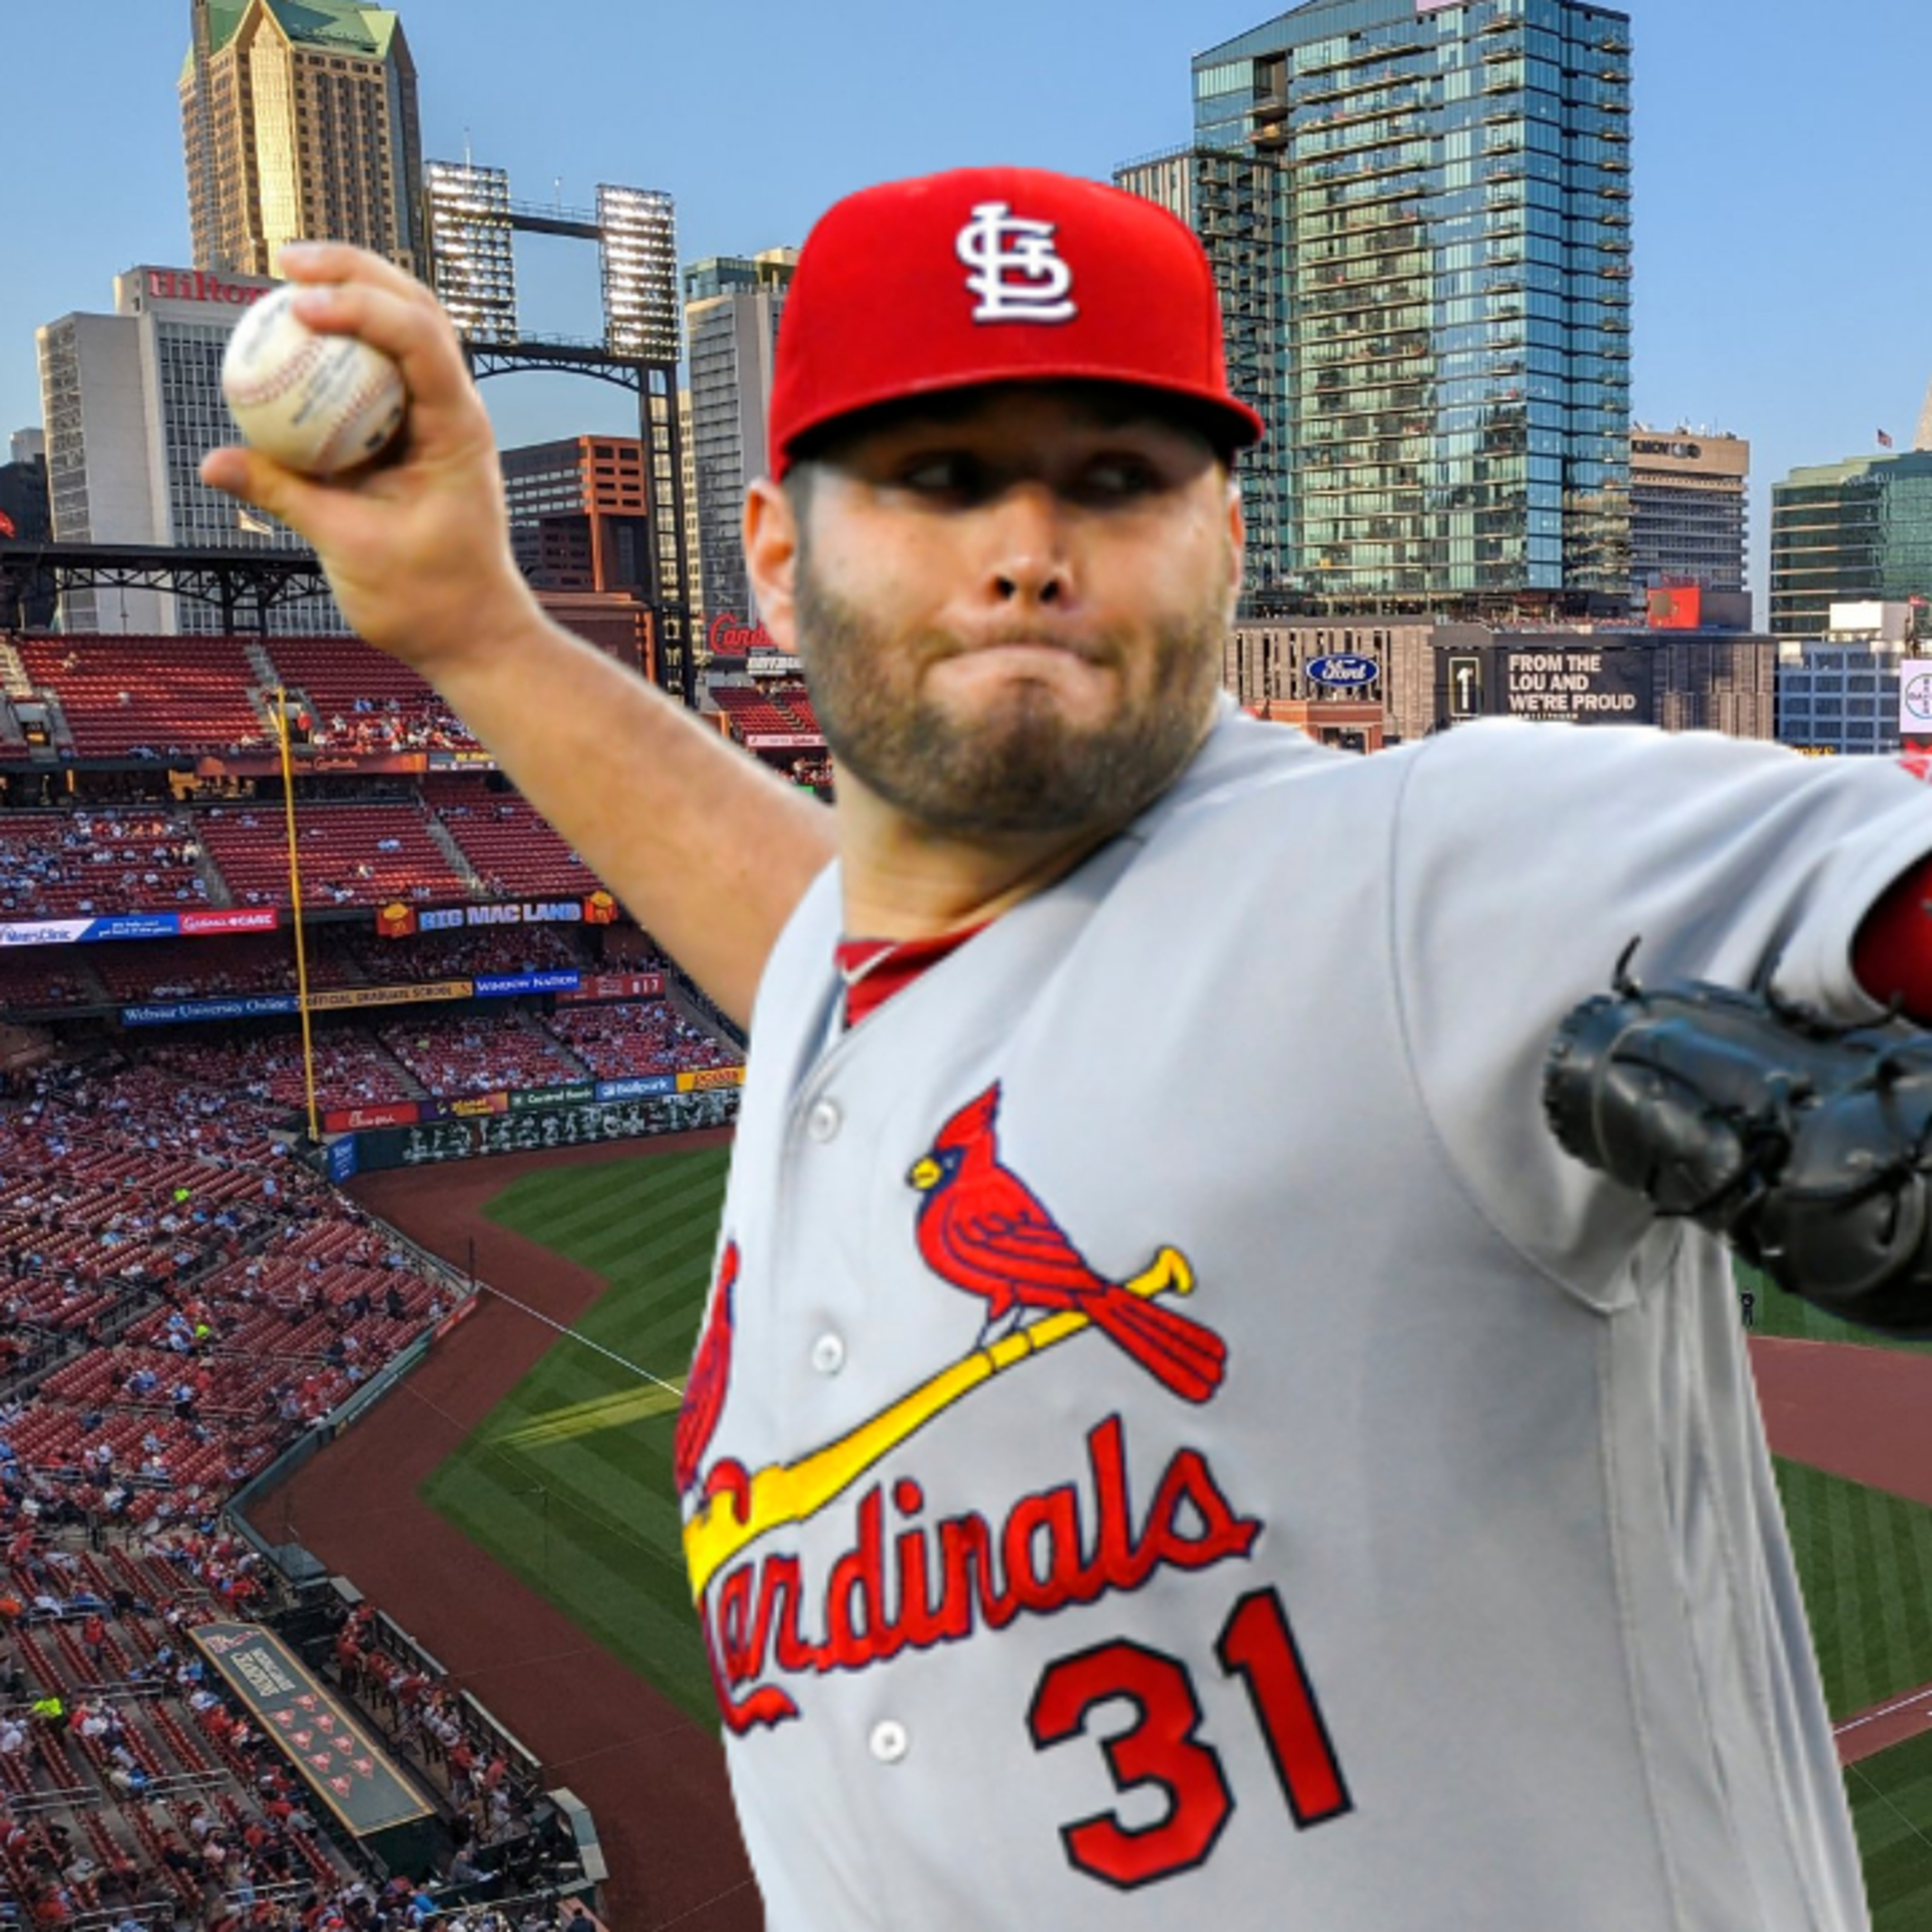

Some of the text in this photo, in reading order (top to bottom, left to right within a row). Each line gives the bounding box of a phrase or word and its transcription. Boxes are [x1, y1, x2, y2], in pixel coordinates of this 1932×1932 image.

[1322, 659, 1367, 680] Ford
[1508, 654, 1602, 672] FROM THE
[1509, 674, 1589, 691] LOU AND
[1508, 693, 1636, 711] WE'RE PROUD
[419, 903, 582, 931] BIG MAC LAND
[179, 1003, 243, 1018] University
[1025, 1584, 1354, 1891] 31
